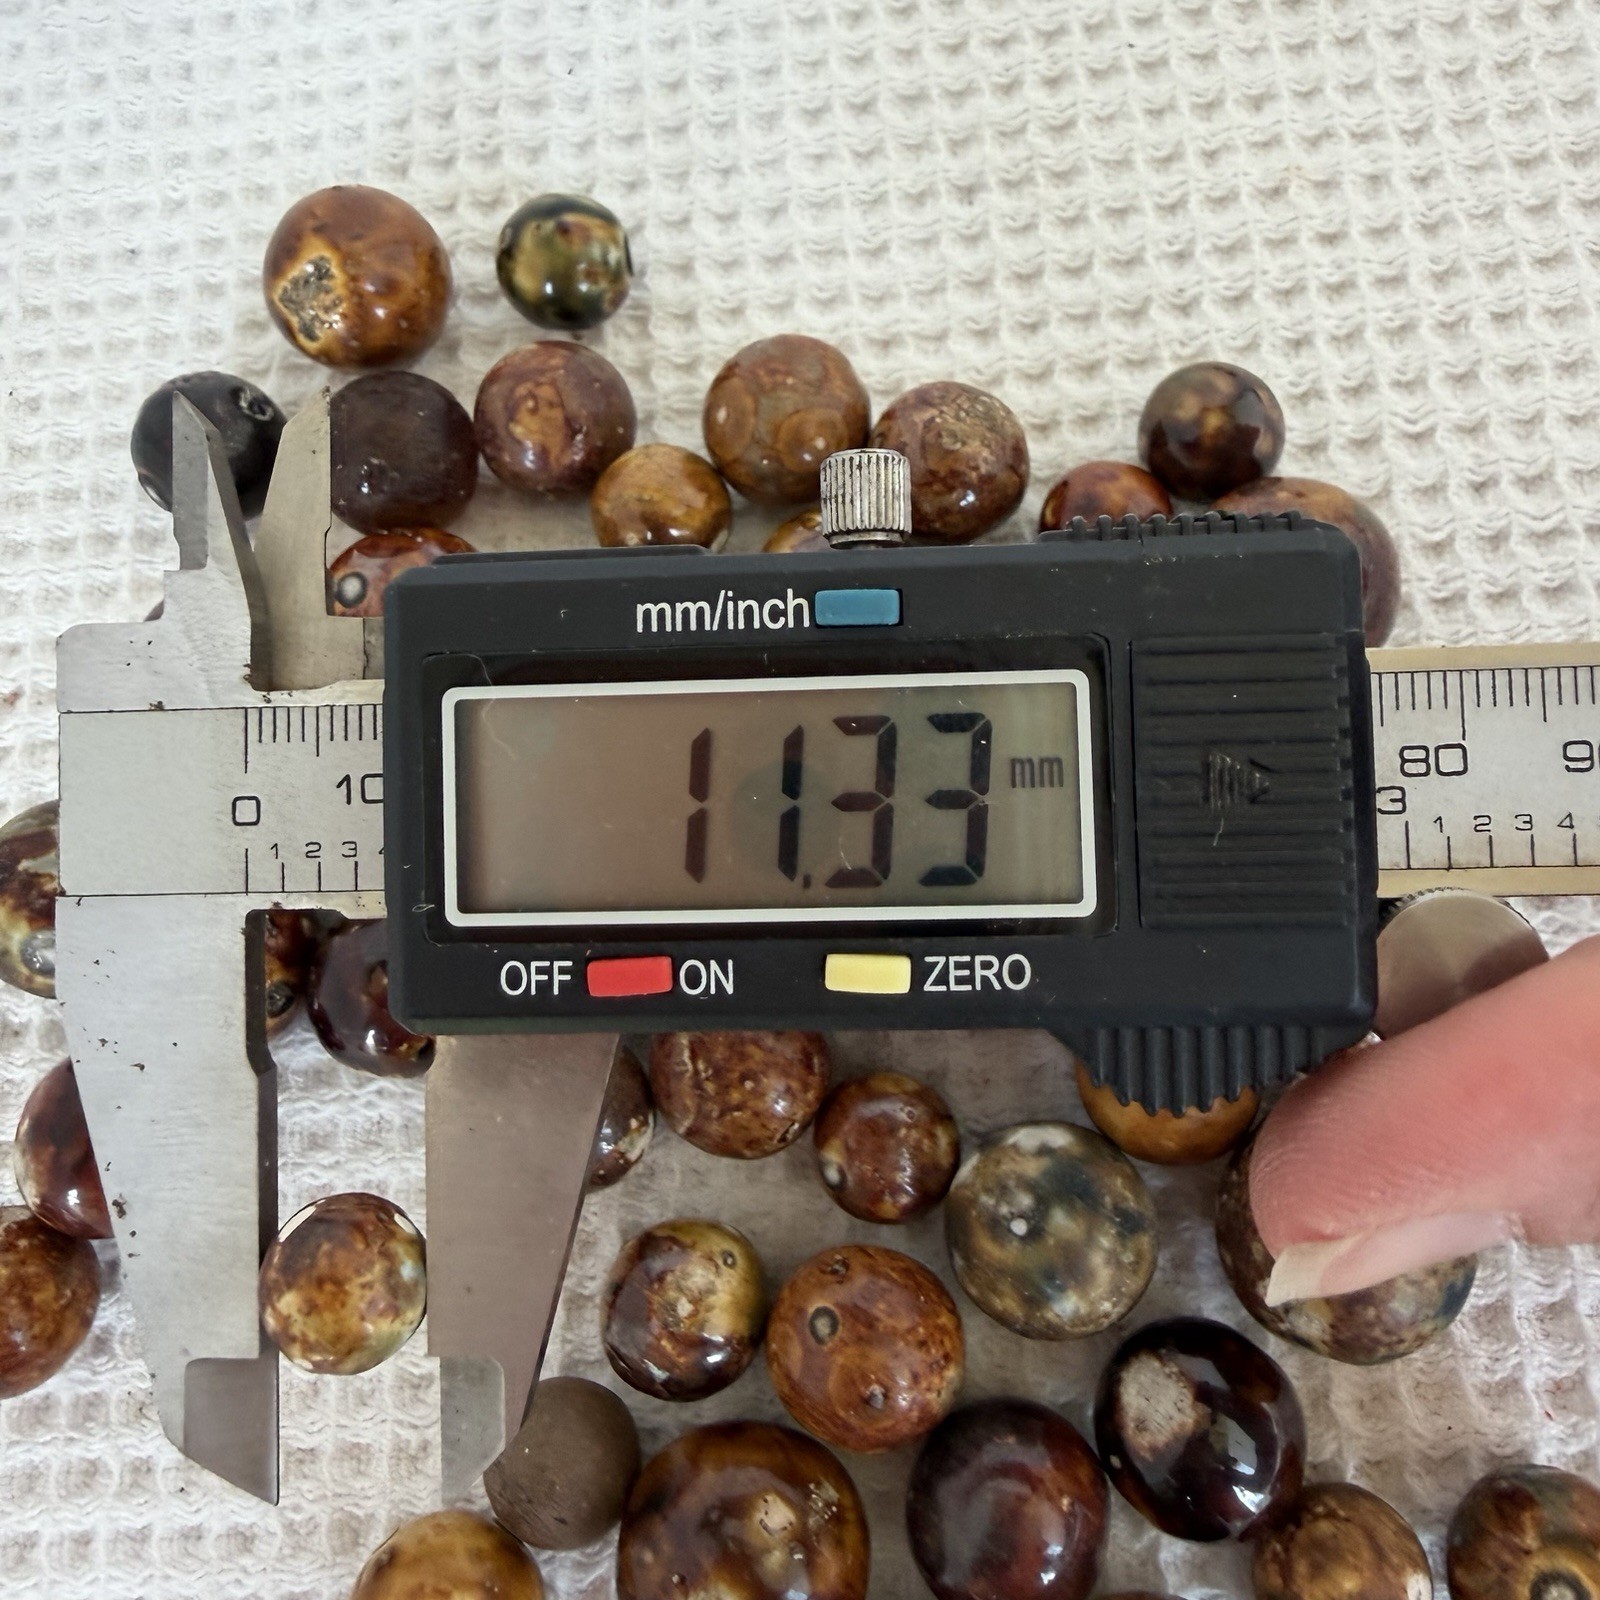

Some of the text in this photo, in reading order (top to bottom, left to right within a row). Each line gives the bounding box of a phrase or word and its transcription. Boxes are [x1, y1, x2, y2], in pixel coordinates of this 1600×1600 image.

[636, 588, 810, 633] mm/inch
[1399, 740, 1600, 777] 80 9
[231, 795, 261, 826] 0
[684, 711, 1065, 890] 11.33 mm
[1376, 785, 1407, 815] 3
[1433, 811, 1575, 834] 1 2 3 4
[270, 842, 279, 860] 1
[305, 841, 322, 859] 2
[341, 840, 358, 858] 3
[500, 959, 735, 996] OFF ON
[923, 953, 1032, 992] ZERO
